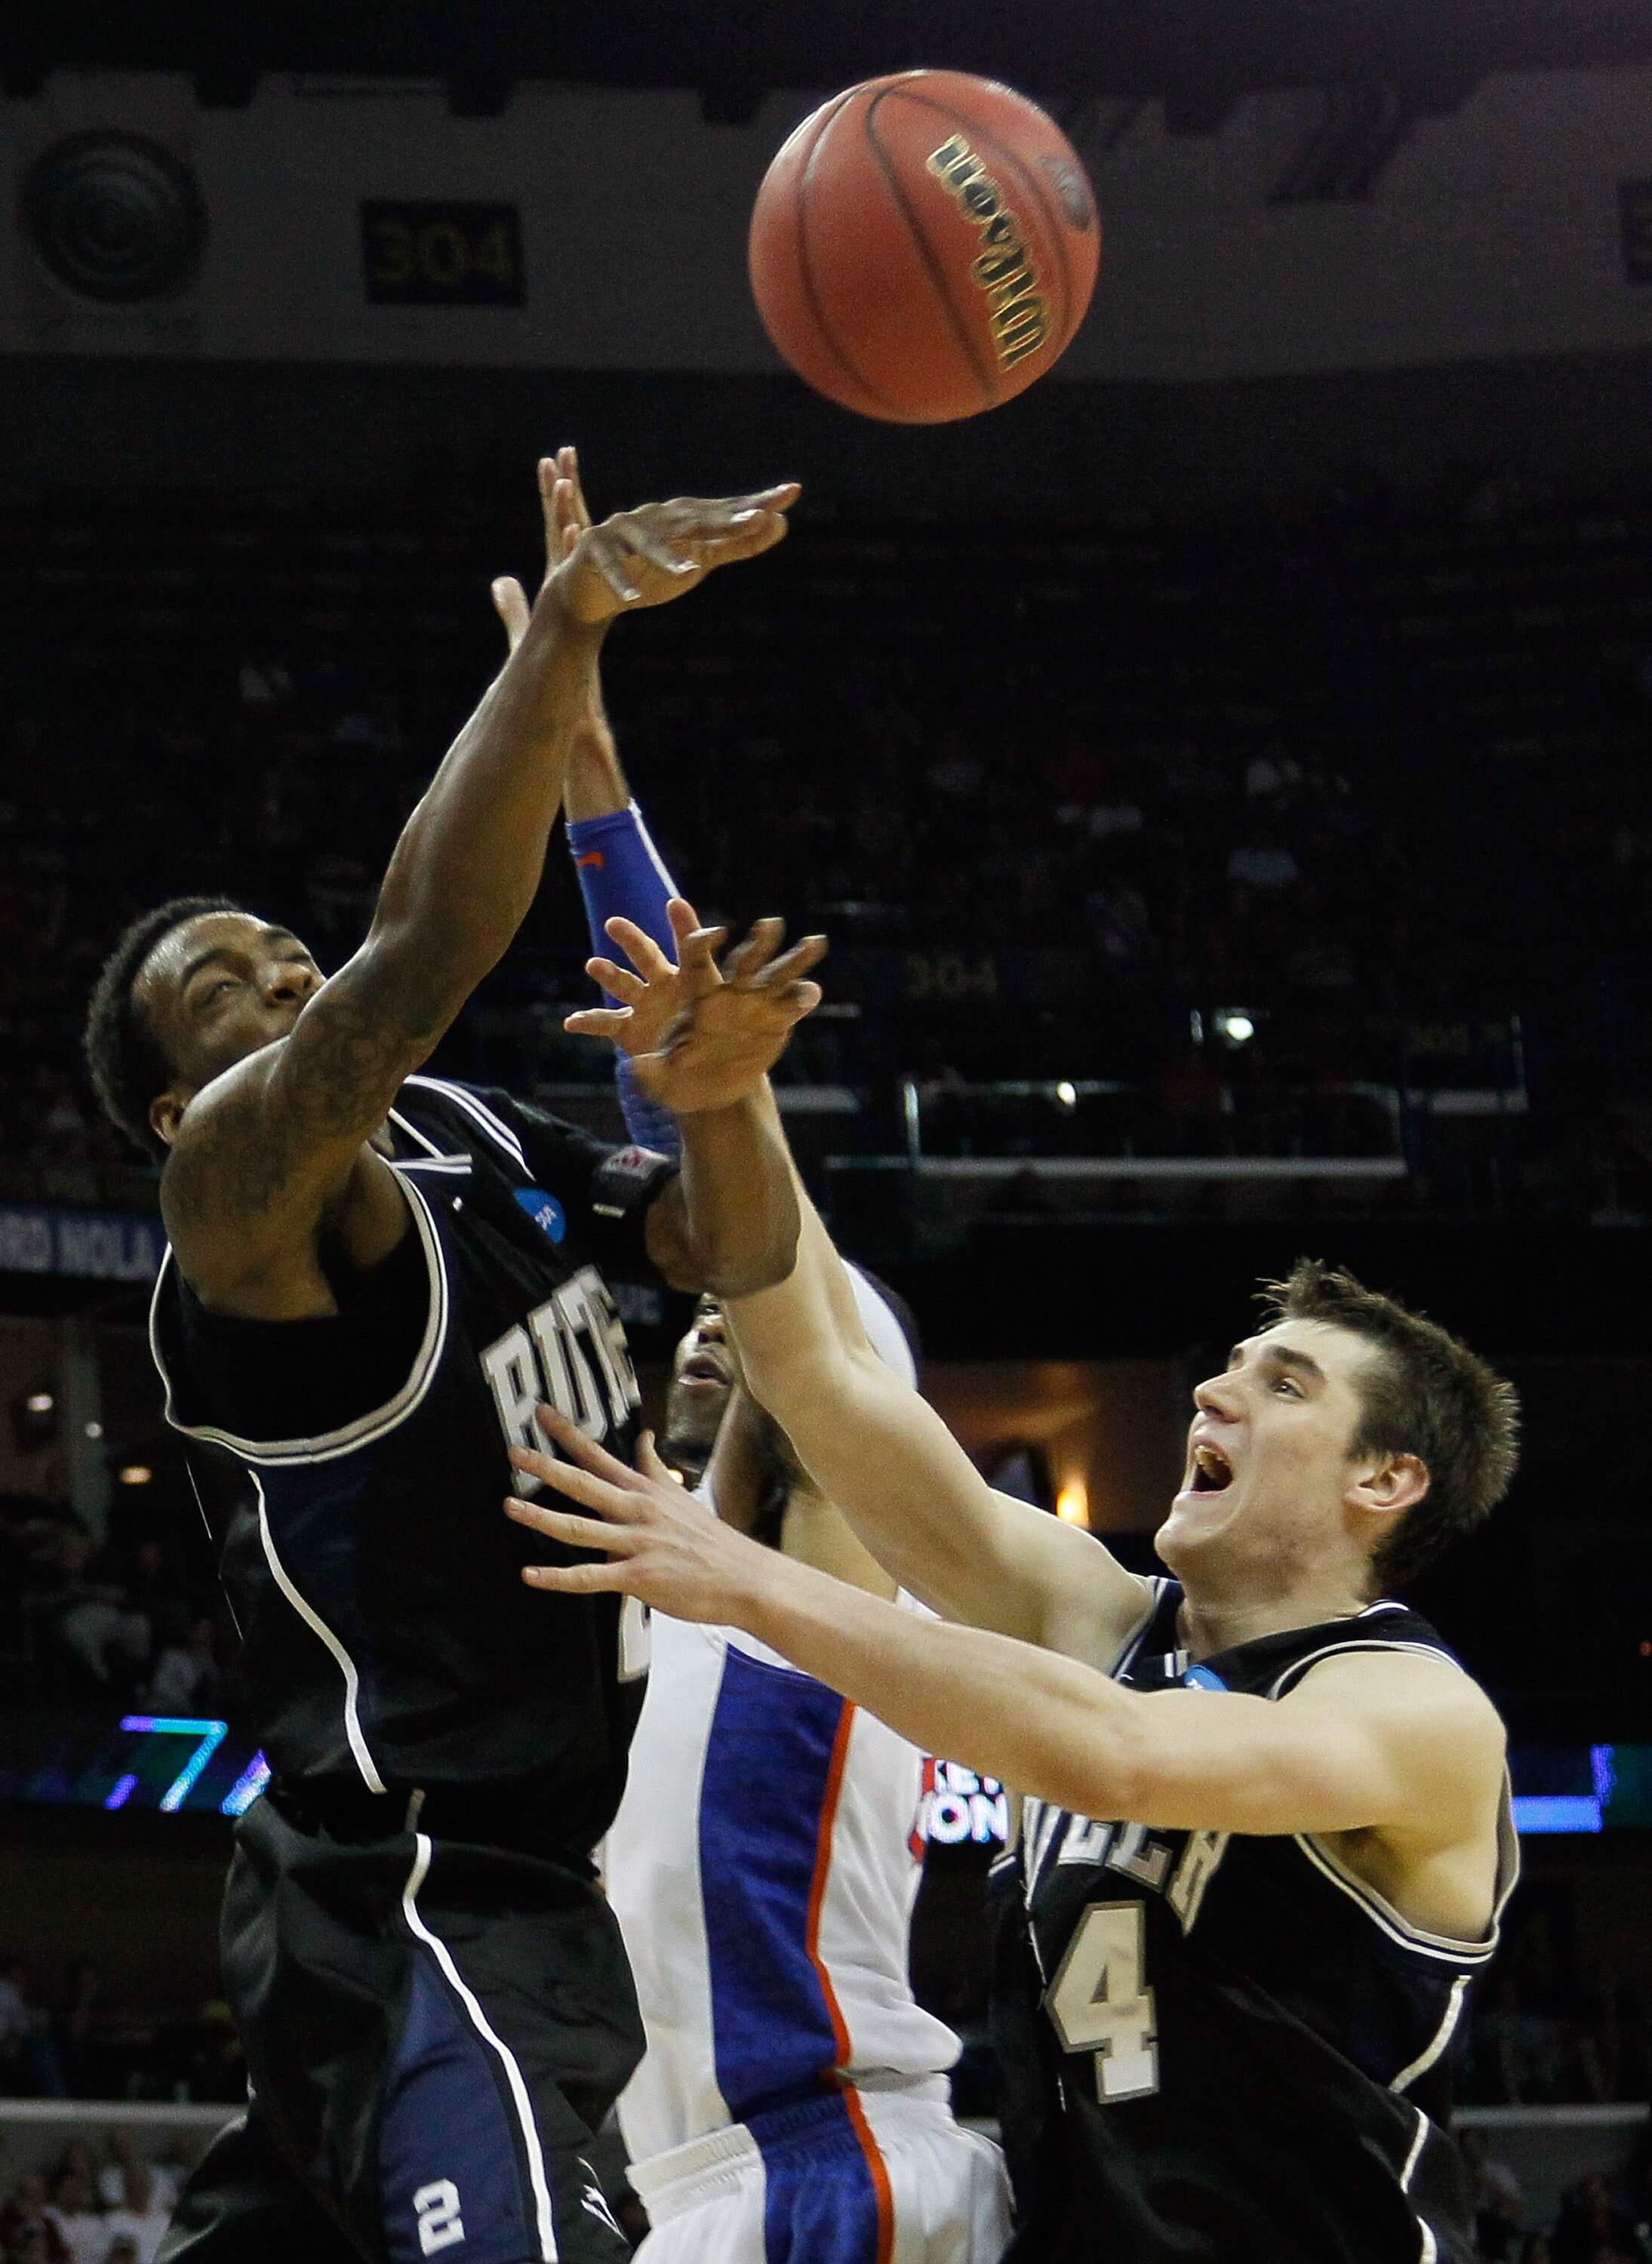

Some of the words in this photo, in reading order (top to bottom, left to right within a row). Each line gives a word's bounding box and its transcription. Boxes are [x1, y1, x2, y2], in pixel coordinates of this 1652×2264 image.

[375, 222, 515, 285] 304
[58, 1217, 157, 1281] NOLA
[1044, 1899, 1160, 2105] 4
[412, 2178, 466, 2257] 2
